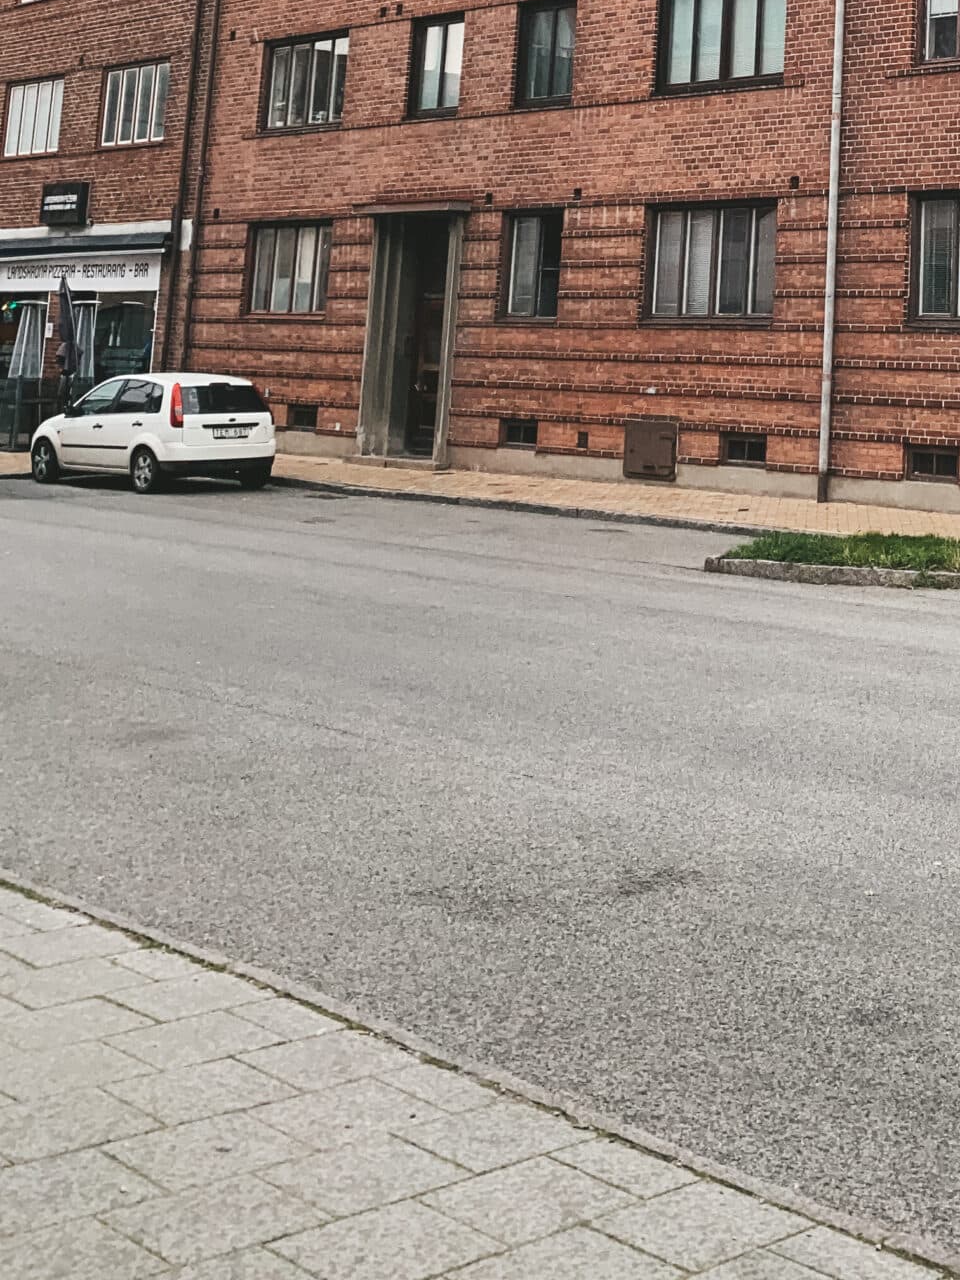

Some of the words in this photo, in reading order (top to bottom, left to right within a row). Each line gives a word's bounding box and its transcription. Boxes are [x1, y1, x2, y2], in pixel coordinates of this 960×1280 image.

[48, 263, 76, 278] PIZZERIA
[82, 263, 126, 279] RESTAURANG
[134, 262, 149, 278] BAR
